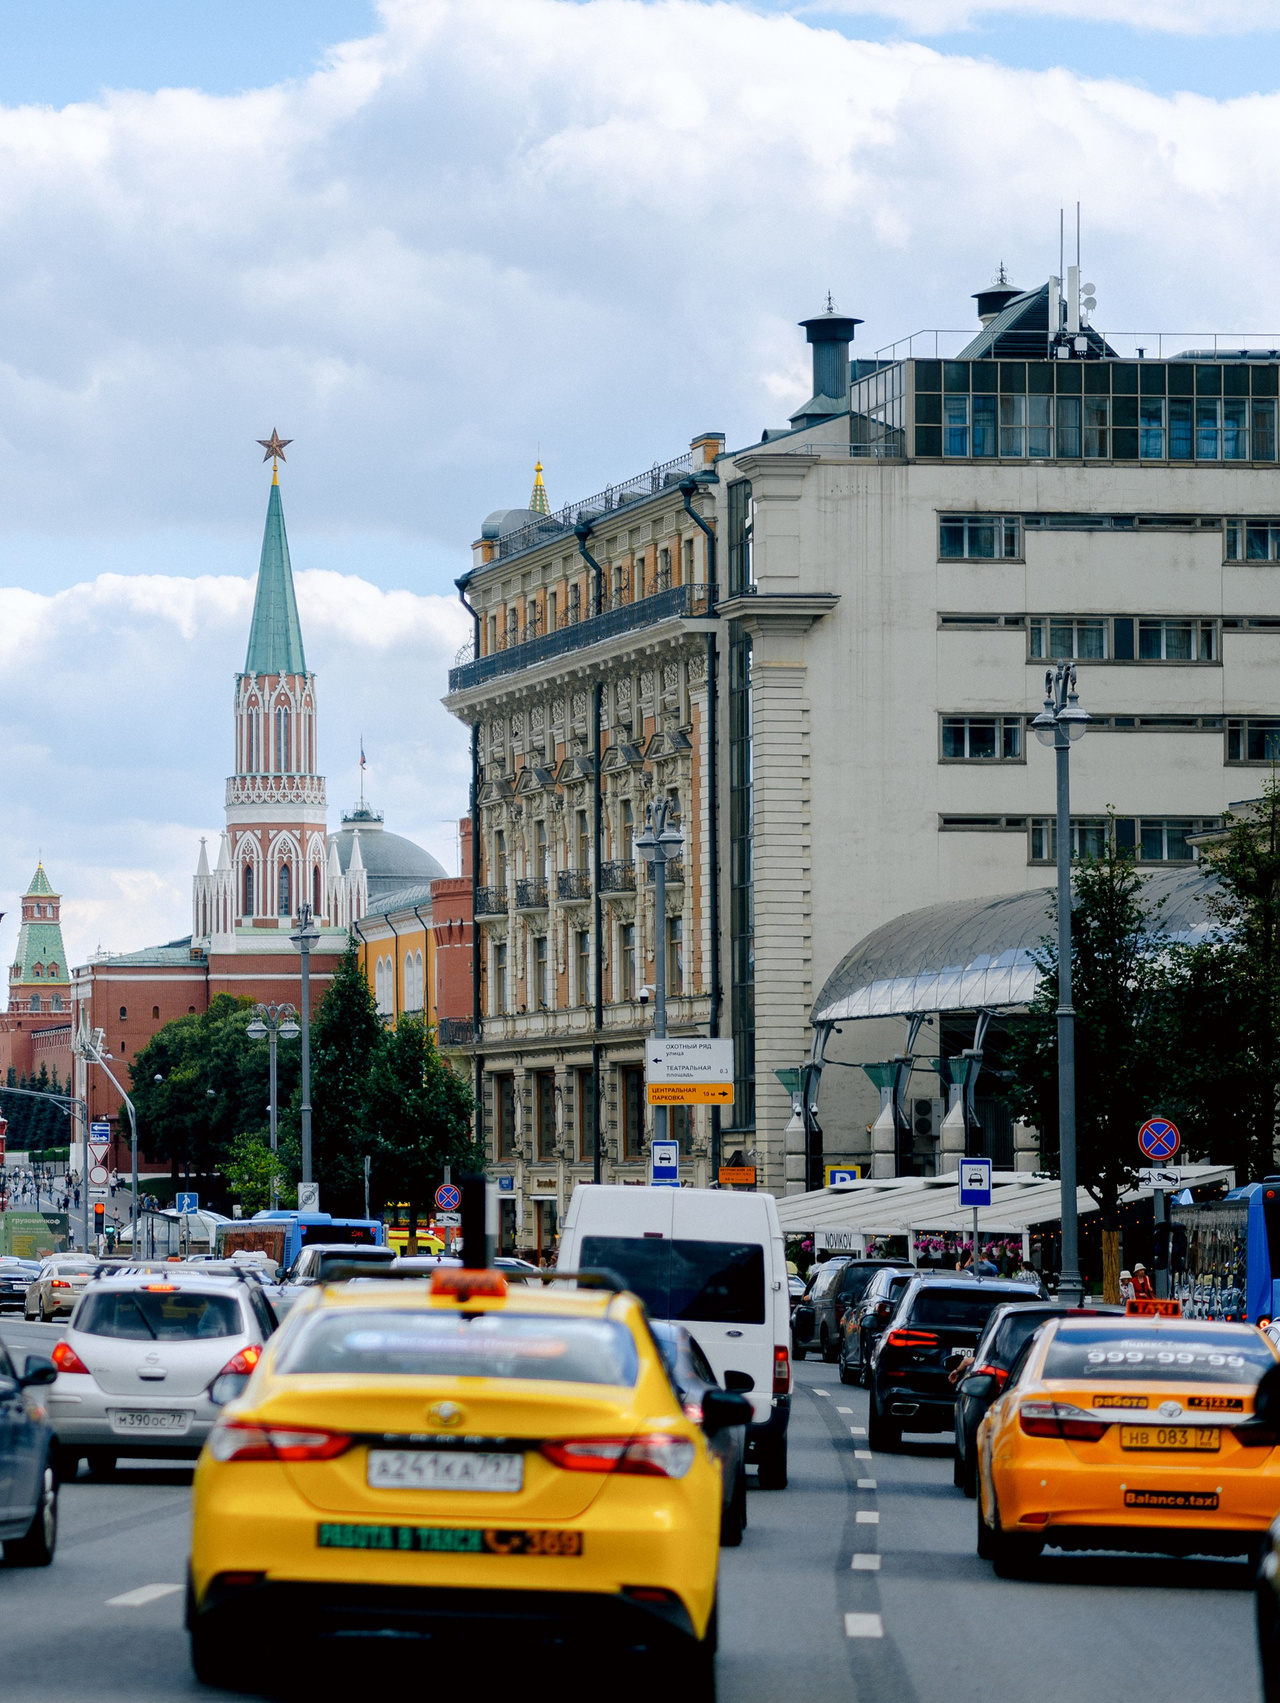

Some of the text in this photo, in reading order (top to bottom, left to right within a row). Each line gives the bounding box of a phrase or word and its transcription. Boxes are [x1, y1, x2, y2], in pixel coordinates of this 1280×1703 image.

[824, 1233, 852, 1249] NOVIKOV
[1134, 1302, 1174, 1314] TAXI
[1087, 1351, 1245, 1368] 999-99-99
[1094, 1396, 1148, 1408] работа
[1129, 1429, 1214, 1445] НВ 083 77
[1125, 1492, 1218, 1506] Balance.taxi
